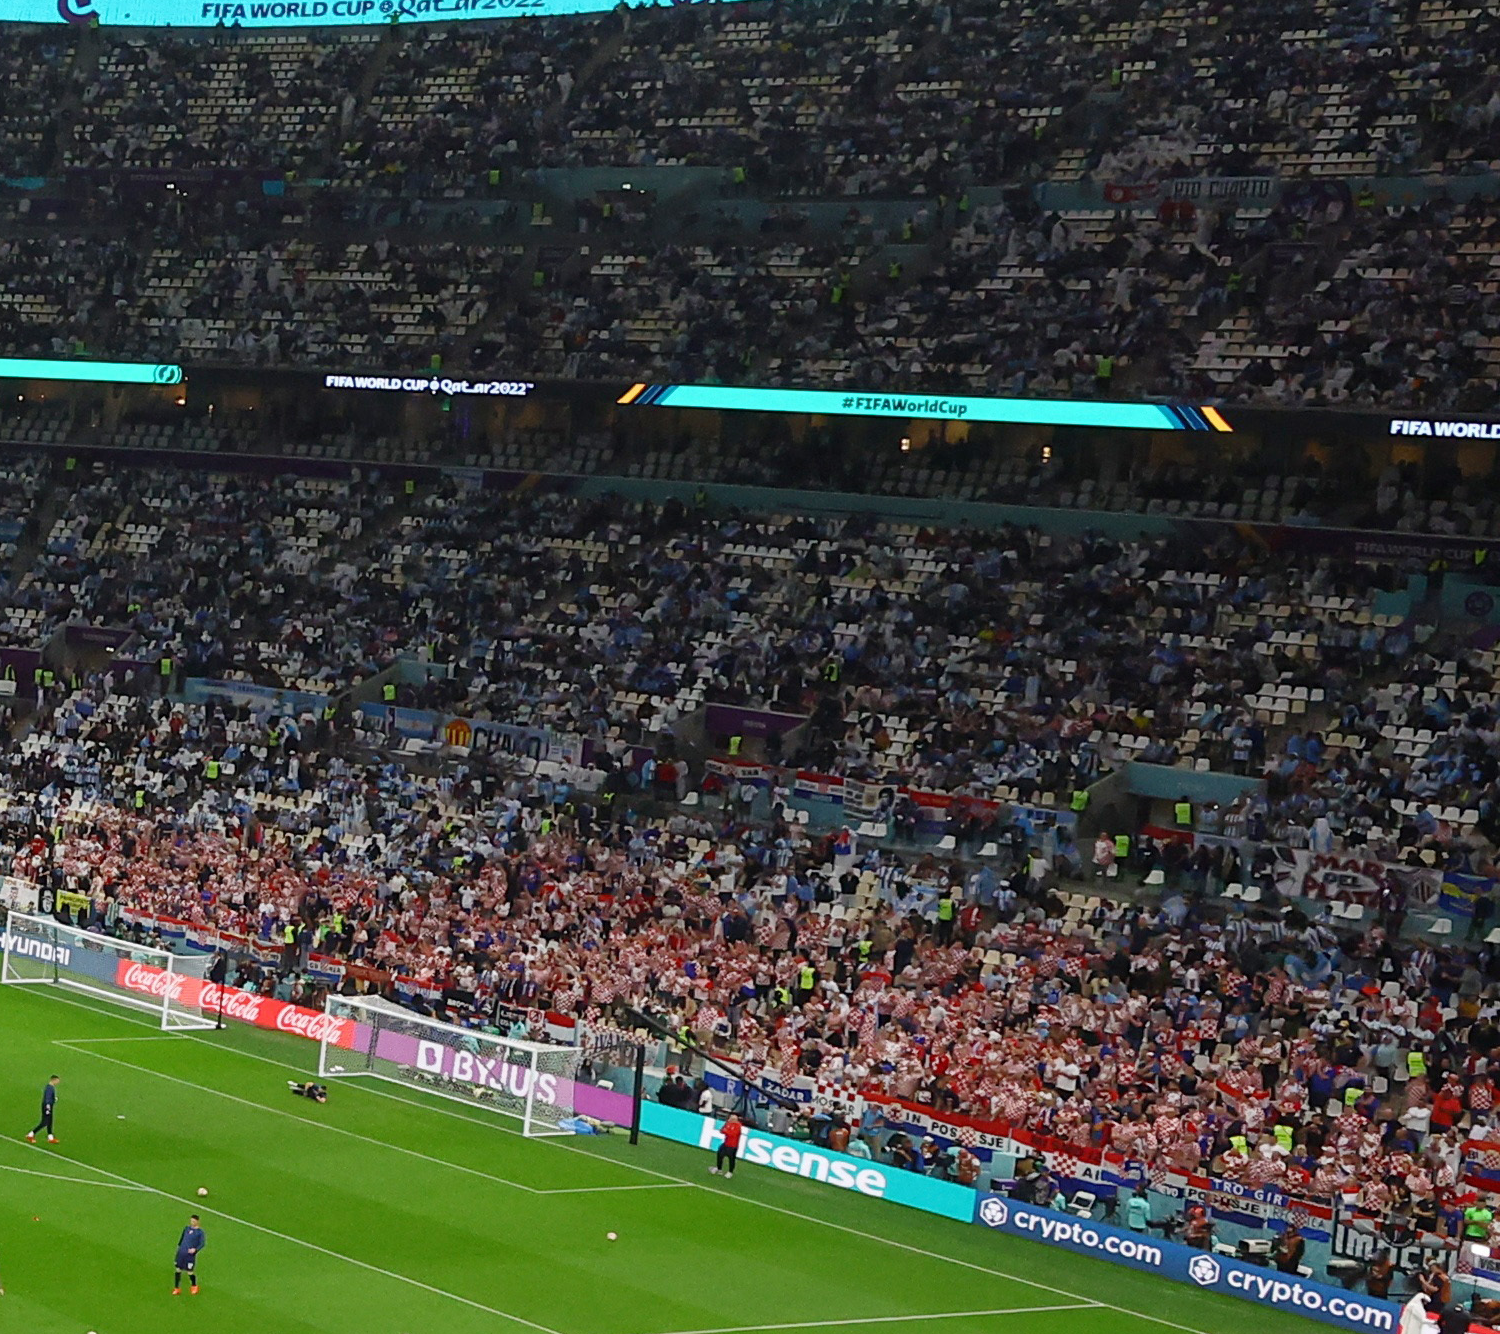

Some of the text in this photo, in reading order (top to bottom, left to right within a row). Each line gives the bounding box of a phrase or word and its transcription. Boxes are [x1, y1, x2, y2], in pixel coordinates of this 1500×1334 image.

[201, 2, 247, 19] FIFA
[249, 0, 325, 18] WORLD
[332, 0, 375, 15] CUP
[326, 375, 429, 391] FIFA WORLD CUP
[842, 397, 968, 418] #FIFAWorldCup
[1390, 420, 1433, 436] FIFA
[453, 1049, 558, 1105] BYJUS
[765, 1080, 805, 1102] ZADAR
[811, 1096, 855, 1116] MOSAR
[1014, 1208, 1162, 1267] crypto.com
[1227, 1269, 1393, 1331] crypto.com
